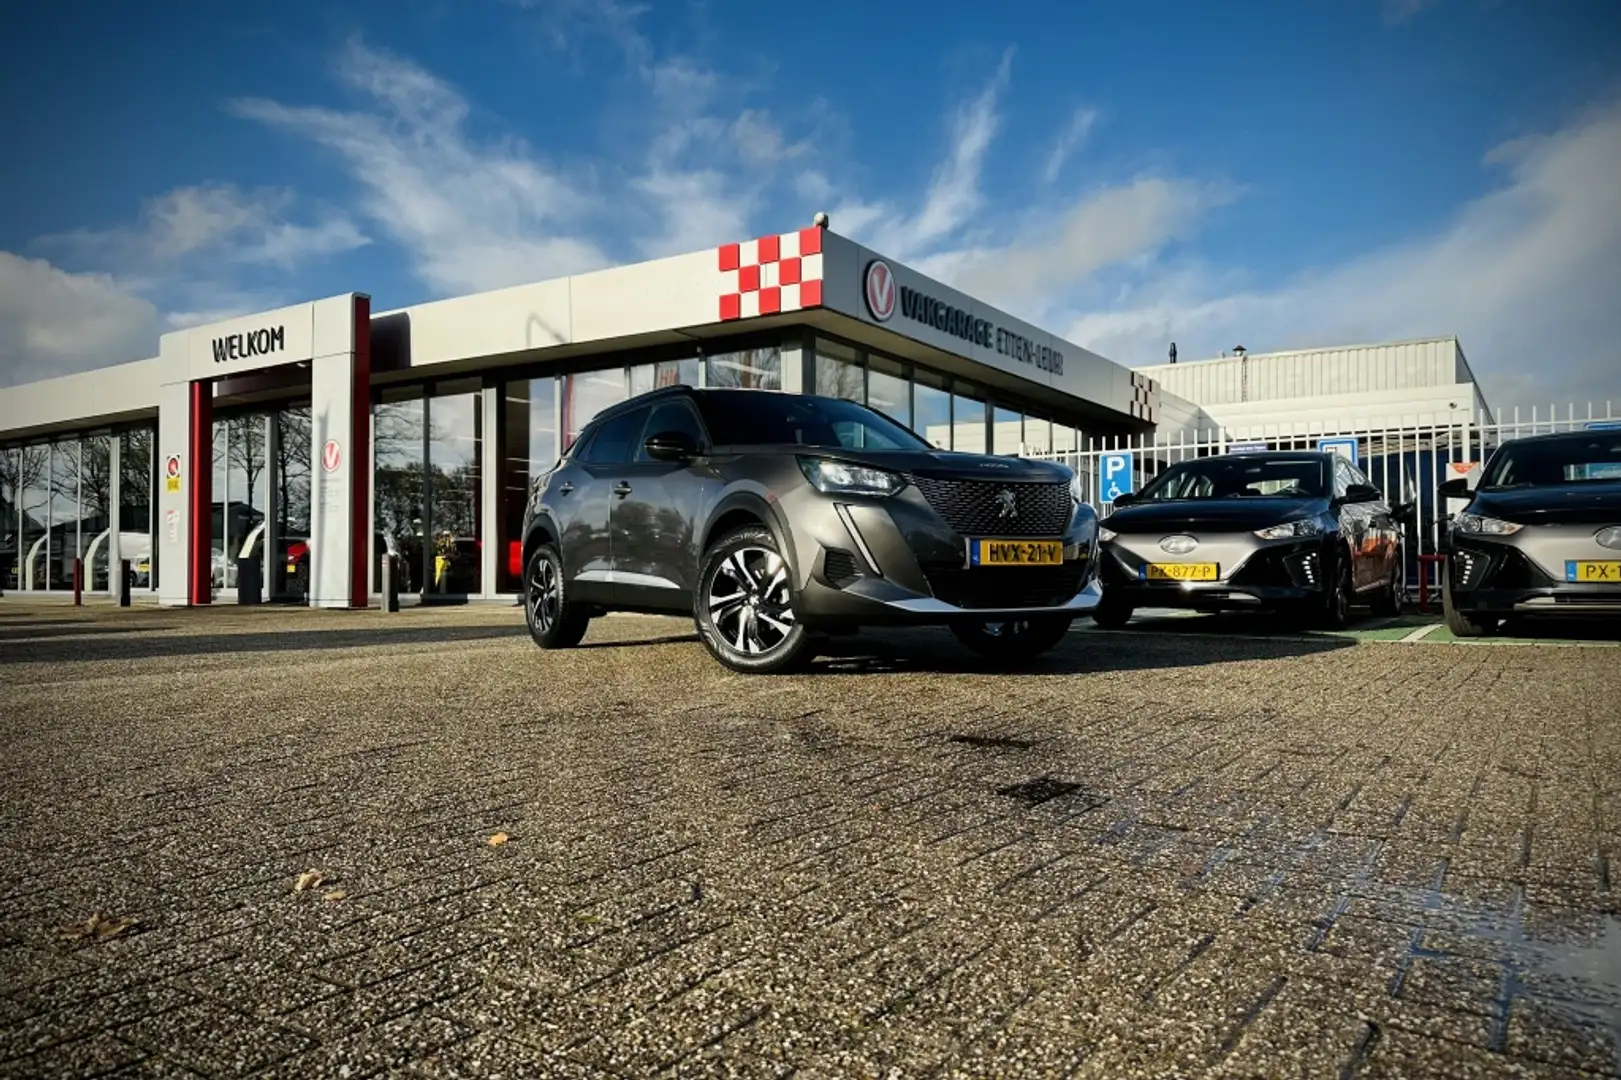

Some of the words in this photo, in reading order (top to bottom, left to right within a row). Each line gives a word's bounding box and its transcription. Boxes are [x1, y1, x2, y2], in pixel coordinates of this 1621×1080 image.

[900, 285, 994, 350] VAKGARAGE
[212, 325, 284, 363] WELKOM
[1106, 456, 1125, 480] P
